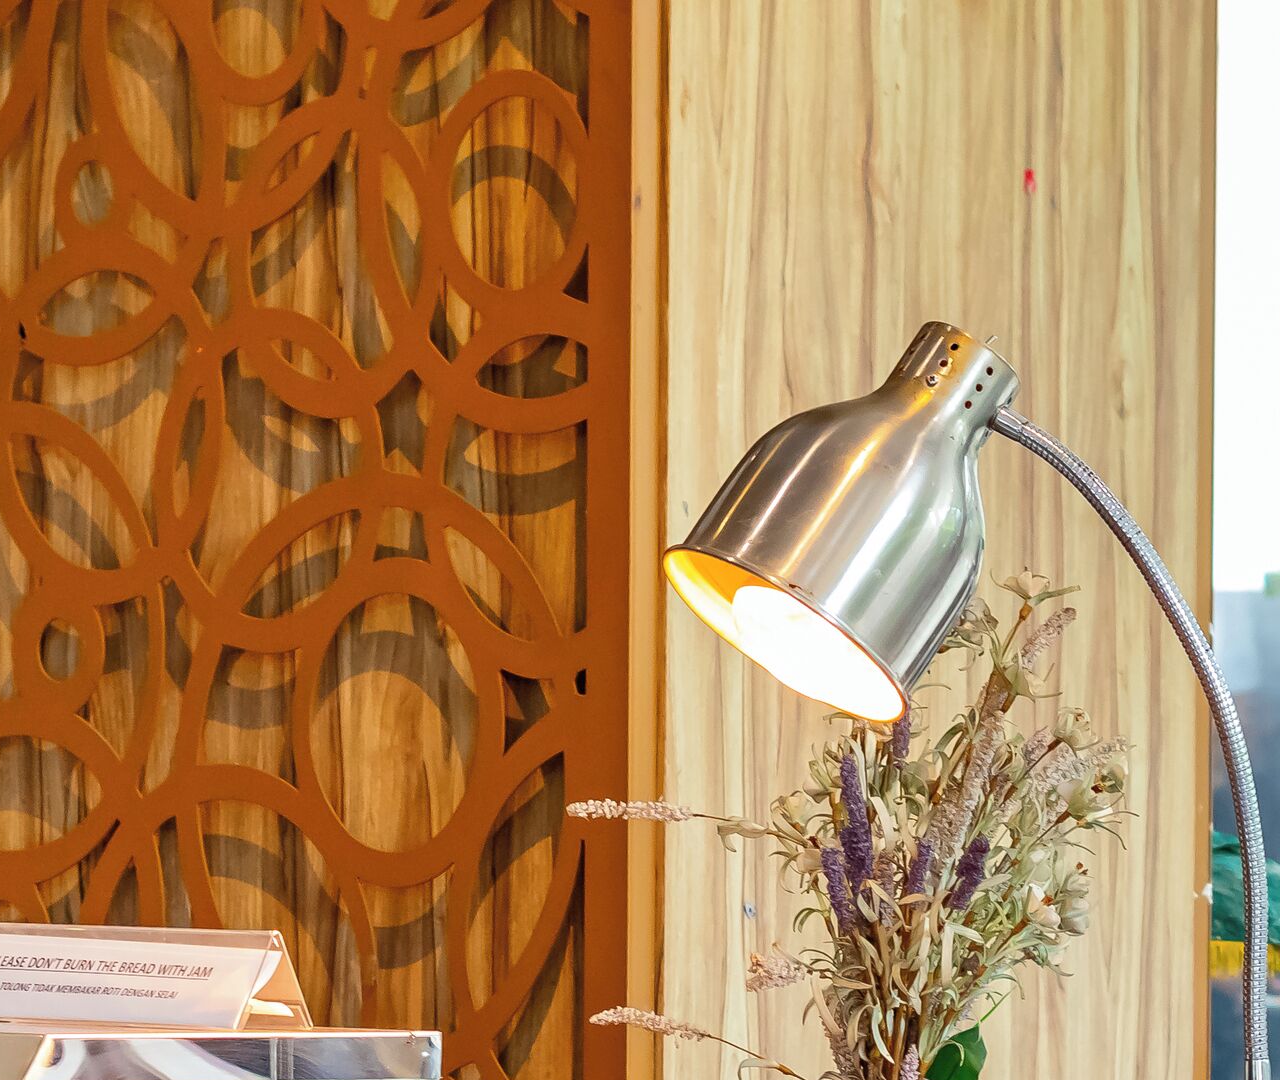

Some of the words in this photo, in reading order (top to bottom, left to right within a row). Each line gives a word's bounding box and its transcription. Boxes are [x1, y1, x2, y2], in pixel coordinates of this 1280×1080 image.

[28, 957, 63, 969] DON'T
[63, 959, 95, 970] BURN
[96, 960, 118, 972] THE
[118, 962, 156, 974] BREAD
[157, 964, 186, 976] WITH
[187, 967, 214, 978] JAM
[0, 982, 33, 991] TOLONG
[33, 983, 57, 992] TIDAK
[56, 985, 102, 994] MEMBAKAR
[102, 987, 121, 996] ROTI
[121, 988, 154, 998] DENGAN
[155, 990, 179, 999] SELAI
